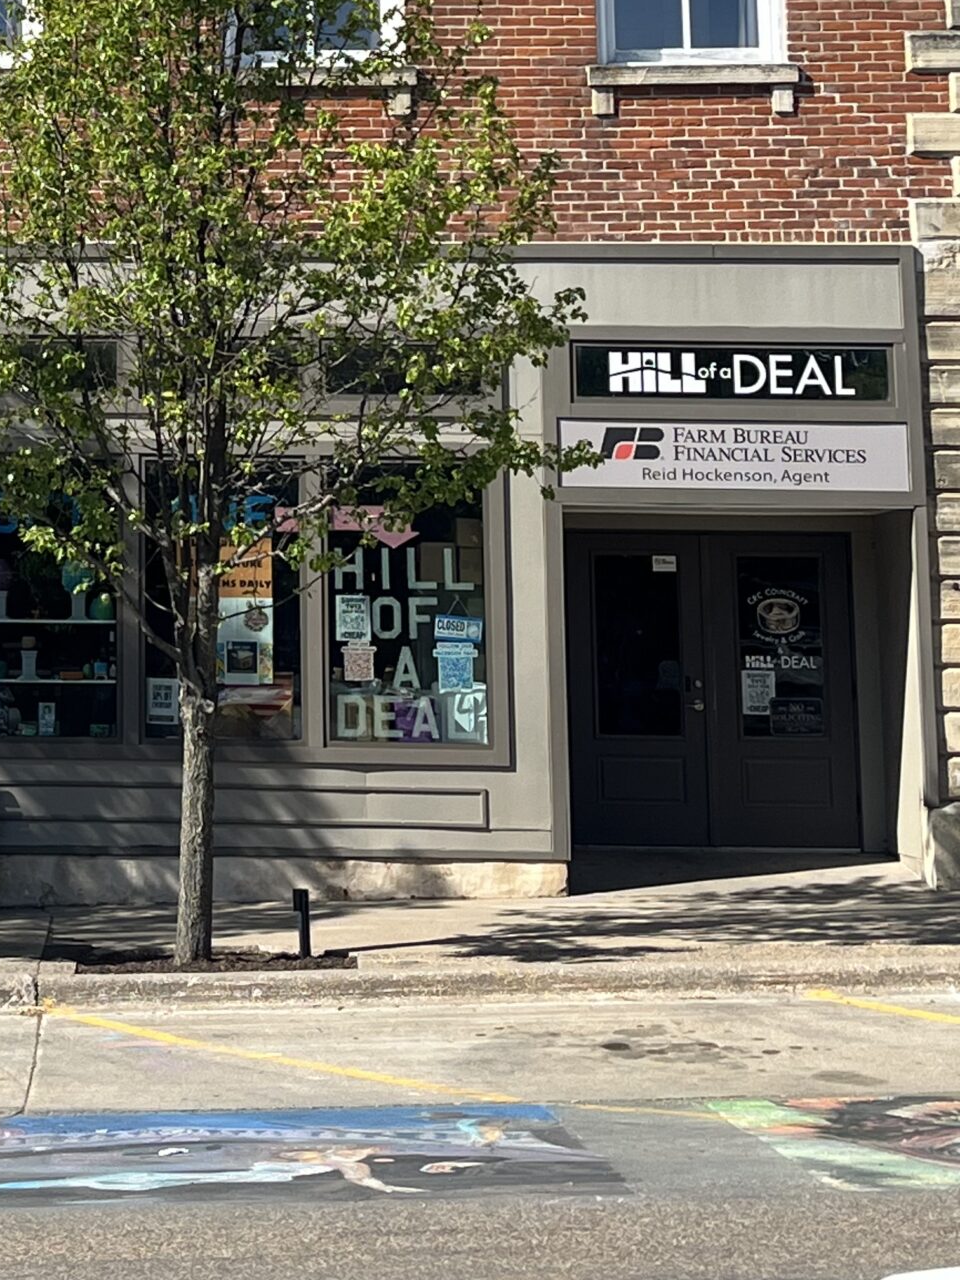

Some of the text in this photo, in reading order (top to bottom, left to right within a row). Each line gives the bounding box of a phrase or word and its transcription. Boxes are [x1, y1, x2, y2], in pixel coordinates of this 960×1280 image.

[697, 362, 717, 379] of
[719, 366, 732, 379] a
[733, 353, 856, 395] DEAL
[673, 427, 809, 445] FARM BUREAU
[673, 446, 867, 464] FINANCIAL SERVICES
[642, 467, 830, 484] Reid Hockenson, Agent
[334, 547, 475, 591] HILL
[371, 596, 438, 640] OF
[436, 619, 466, 632] CLOSED
[391, 645, 422, 690] A
[780, 655, 818, 669] DEAL
[336, 694, 480, 740] DEAL
